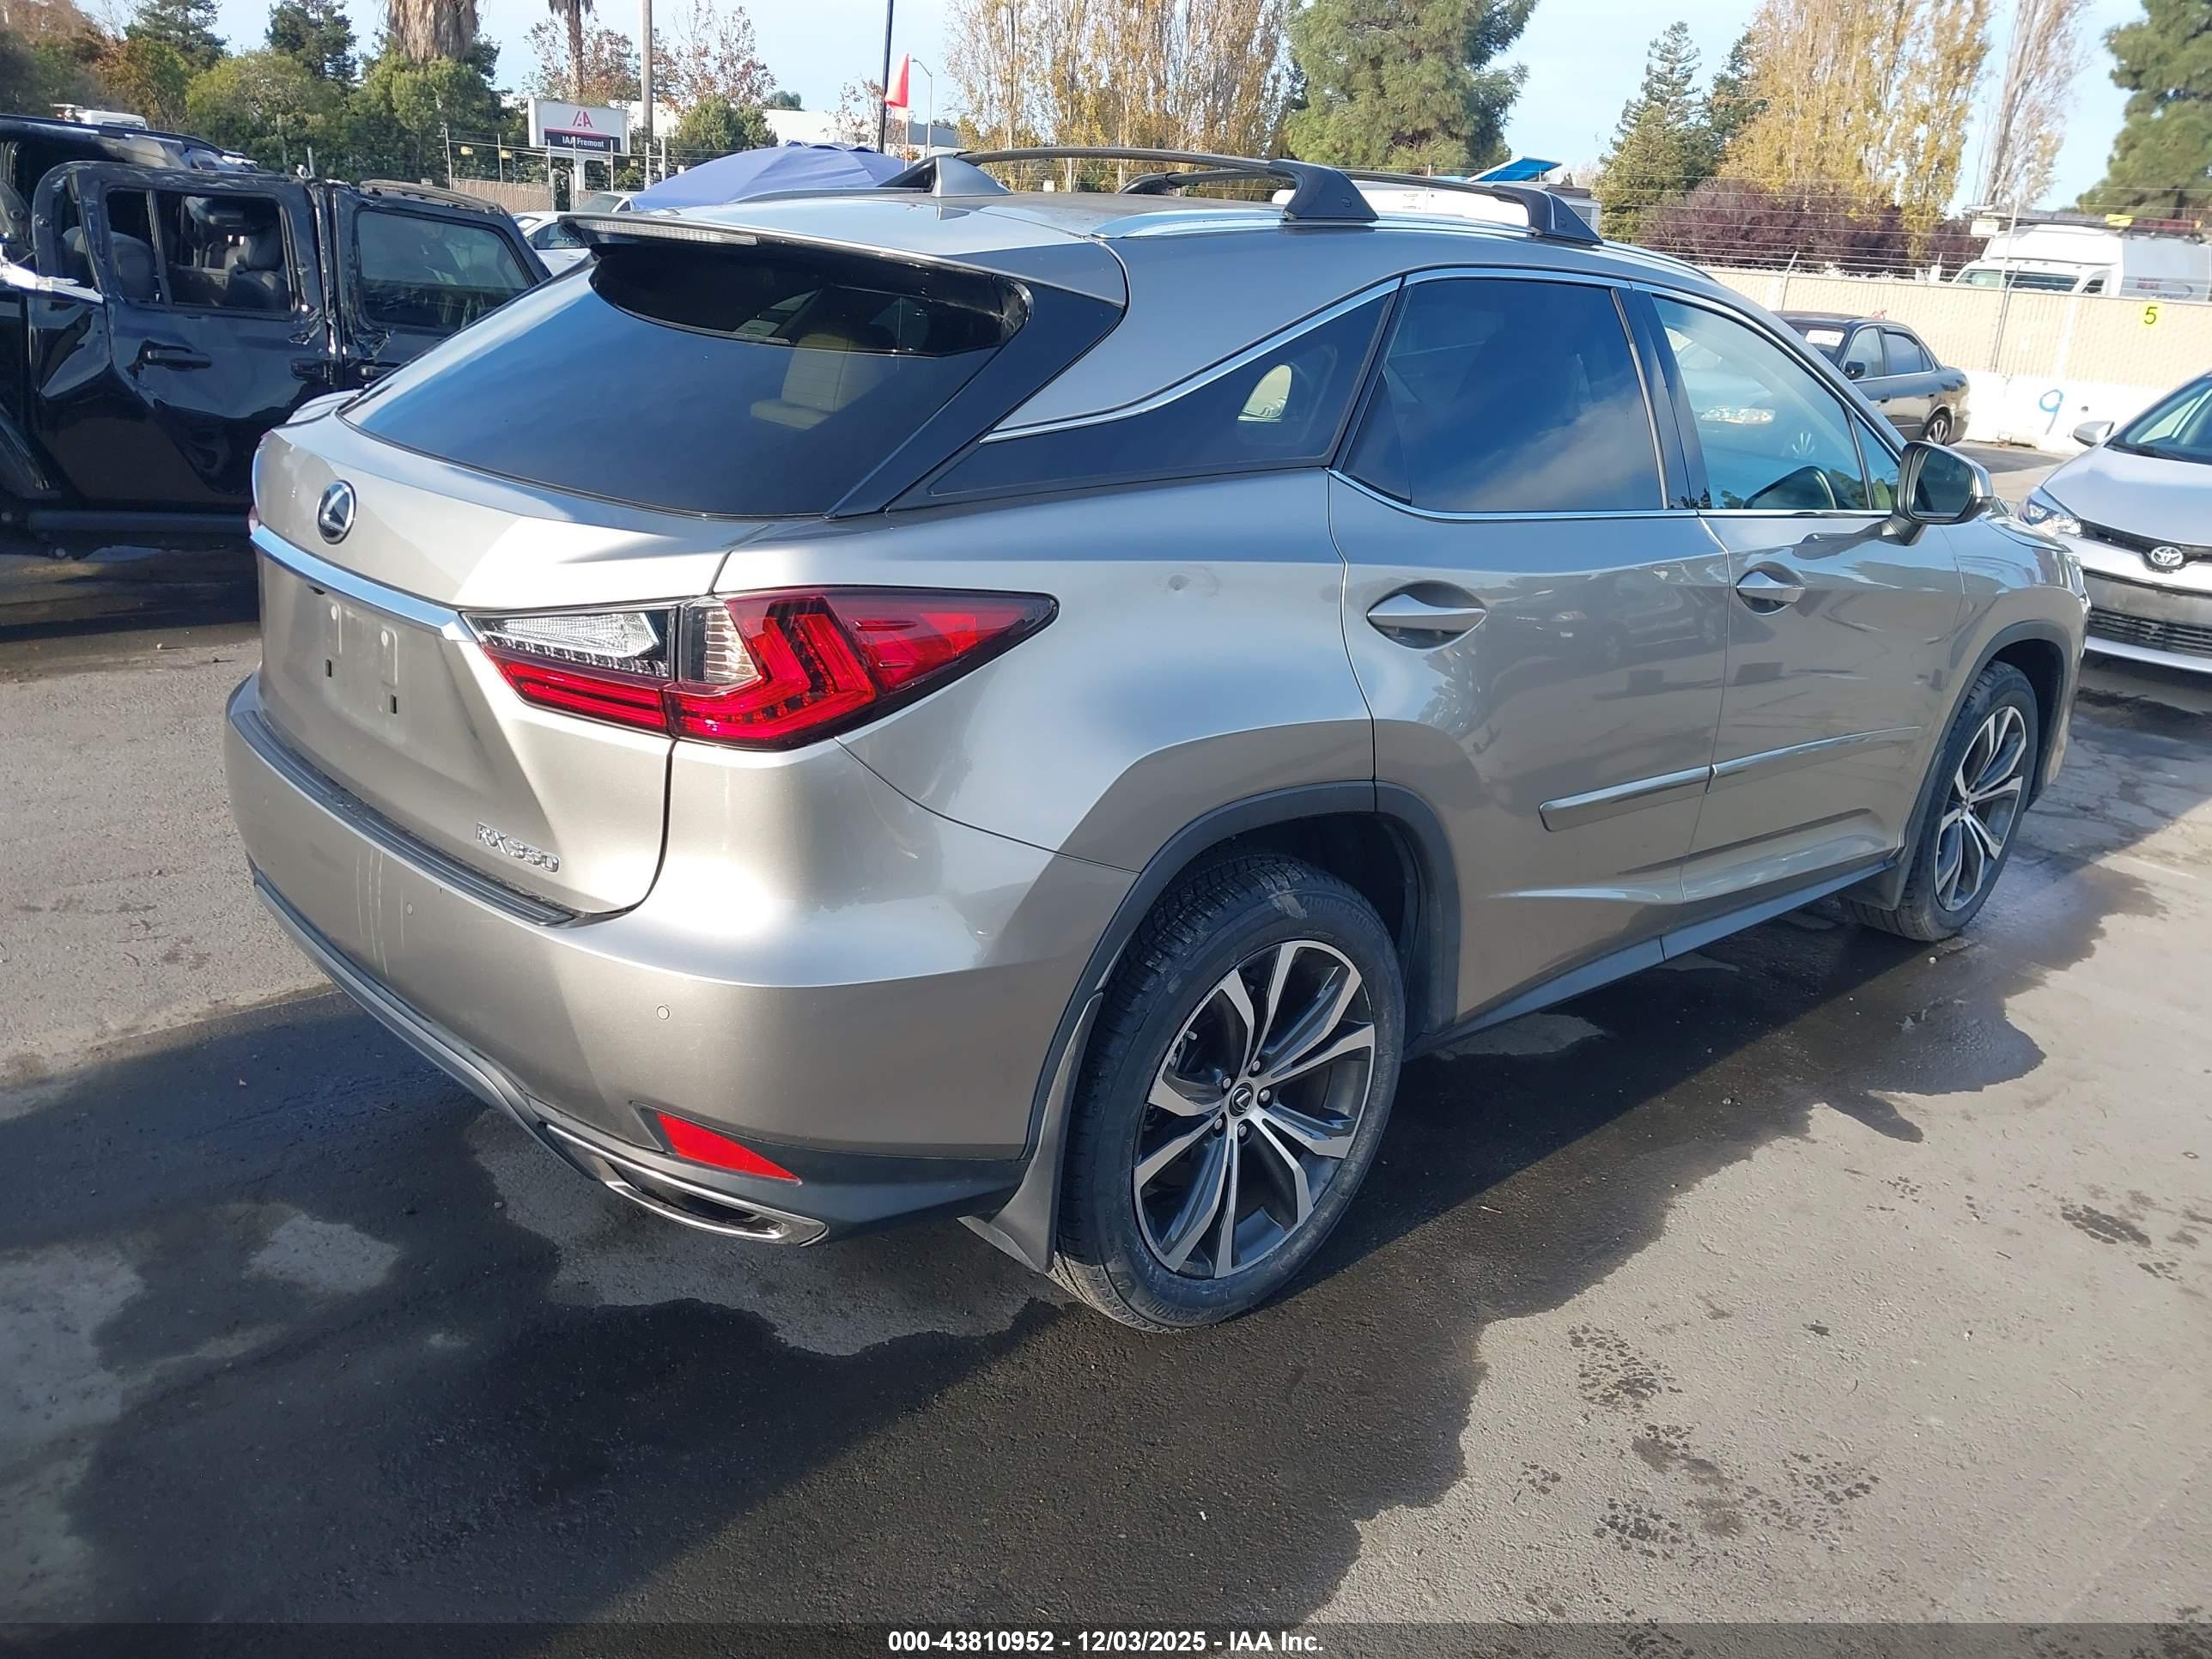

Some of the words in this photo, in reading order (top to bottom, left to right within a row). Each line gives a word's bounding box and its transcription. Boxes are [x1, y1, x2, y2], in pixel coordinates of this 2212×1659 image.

[576, 137, 605, 149] Fremont
[2144, 306, 2158, 325] 5
[2039, 388, 2064, 436] 9
[475, 821, 508, 854] RX
[508, 838, 561, 873] 350
